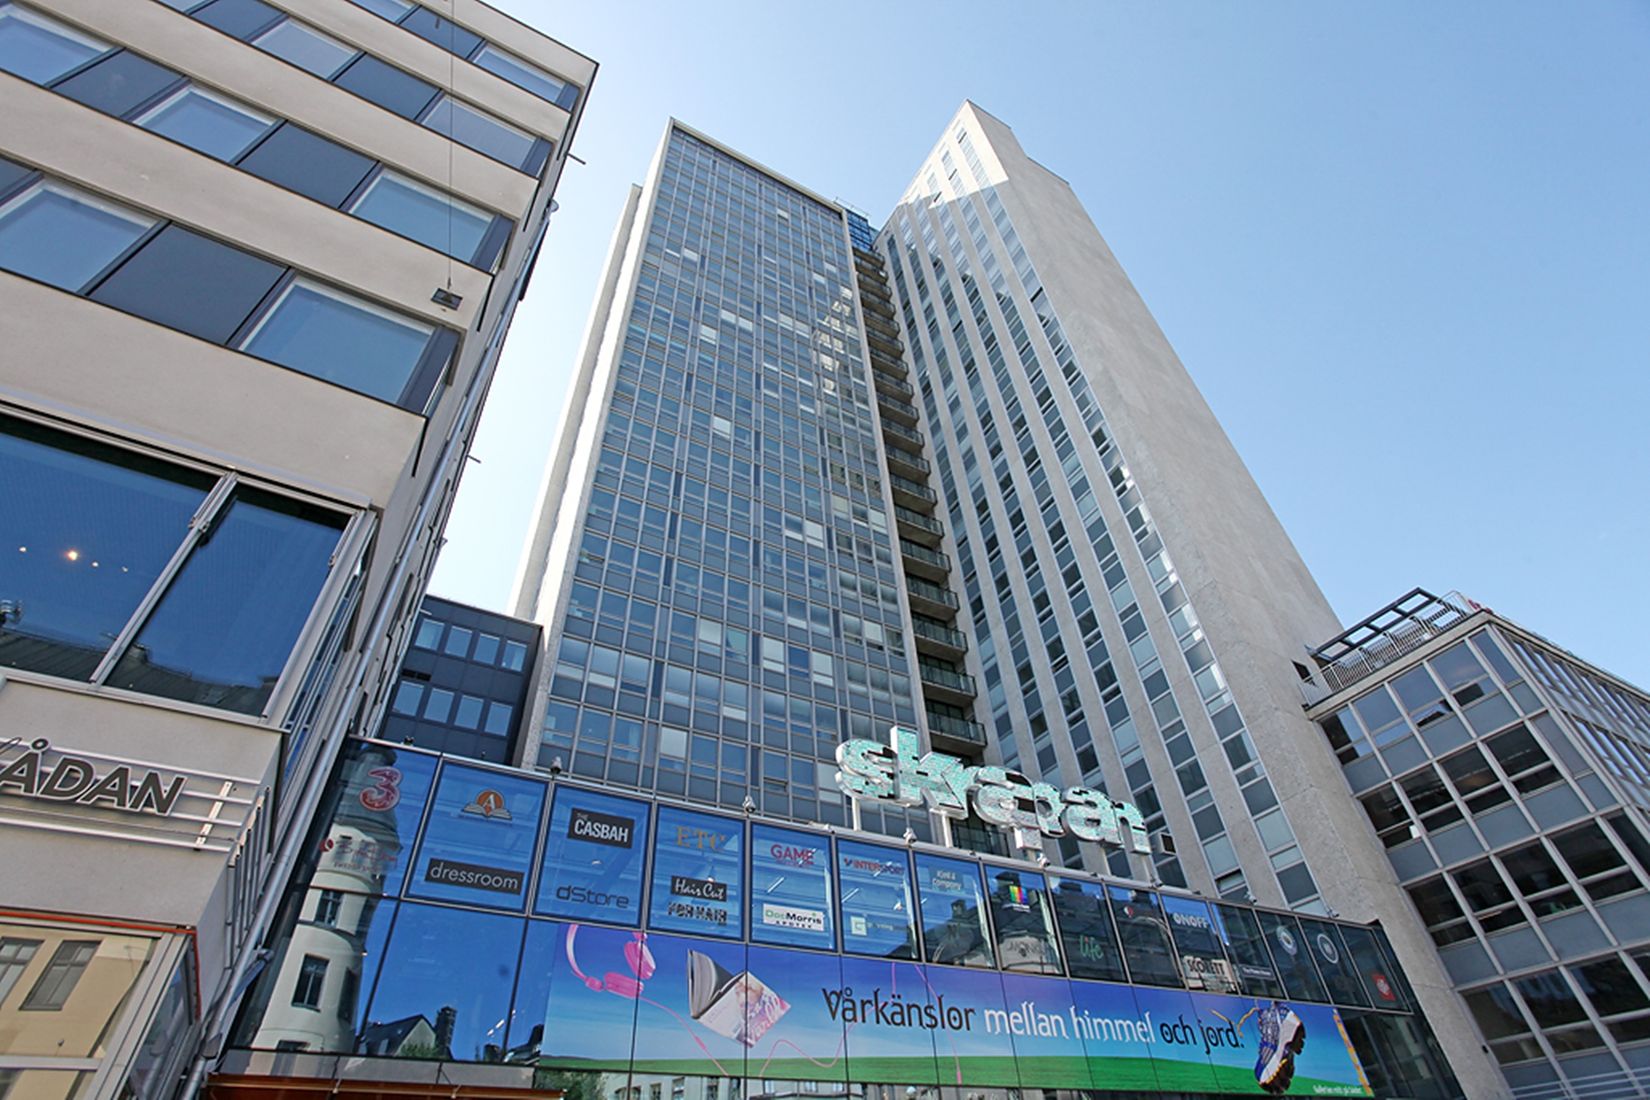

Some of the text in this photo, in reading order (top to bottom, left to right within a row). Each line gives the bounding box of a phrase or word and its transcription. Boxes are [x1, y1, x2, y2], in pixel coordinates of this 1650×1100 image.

[574, 818, 629, 843] CASBAH
[770, 844, 814, 862] GAME
[430, 866, 518, 889] dressroom
[675, 878, 724, 899] Hair Cut
[556, 885, 629, 908] dStore
[765, 909, 822, 924] DocMorris
[984, 1001, 1068, 1040] mellan
[1070, 1005, 1155, 1043] himmel
[1160, 1014, 1197, 1045] och
[1197, 1018, 1244, 1054] jord.
